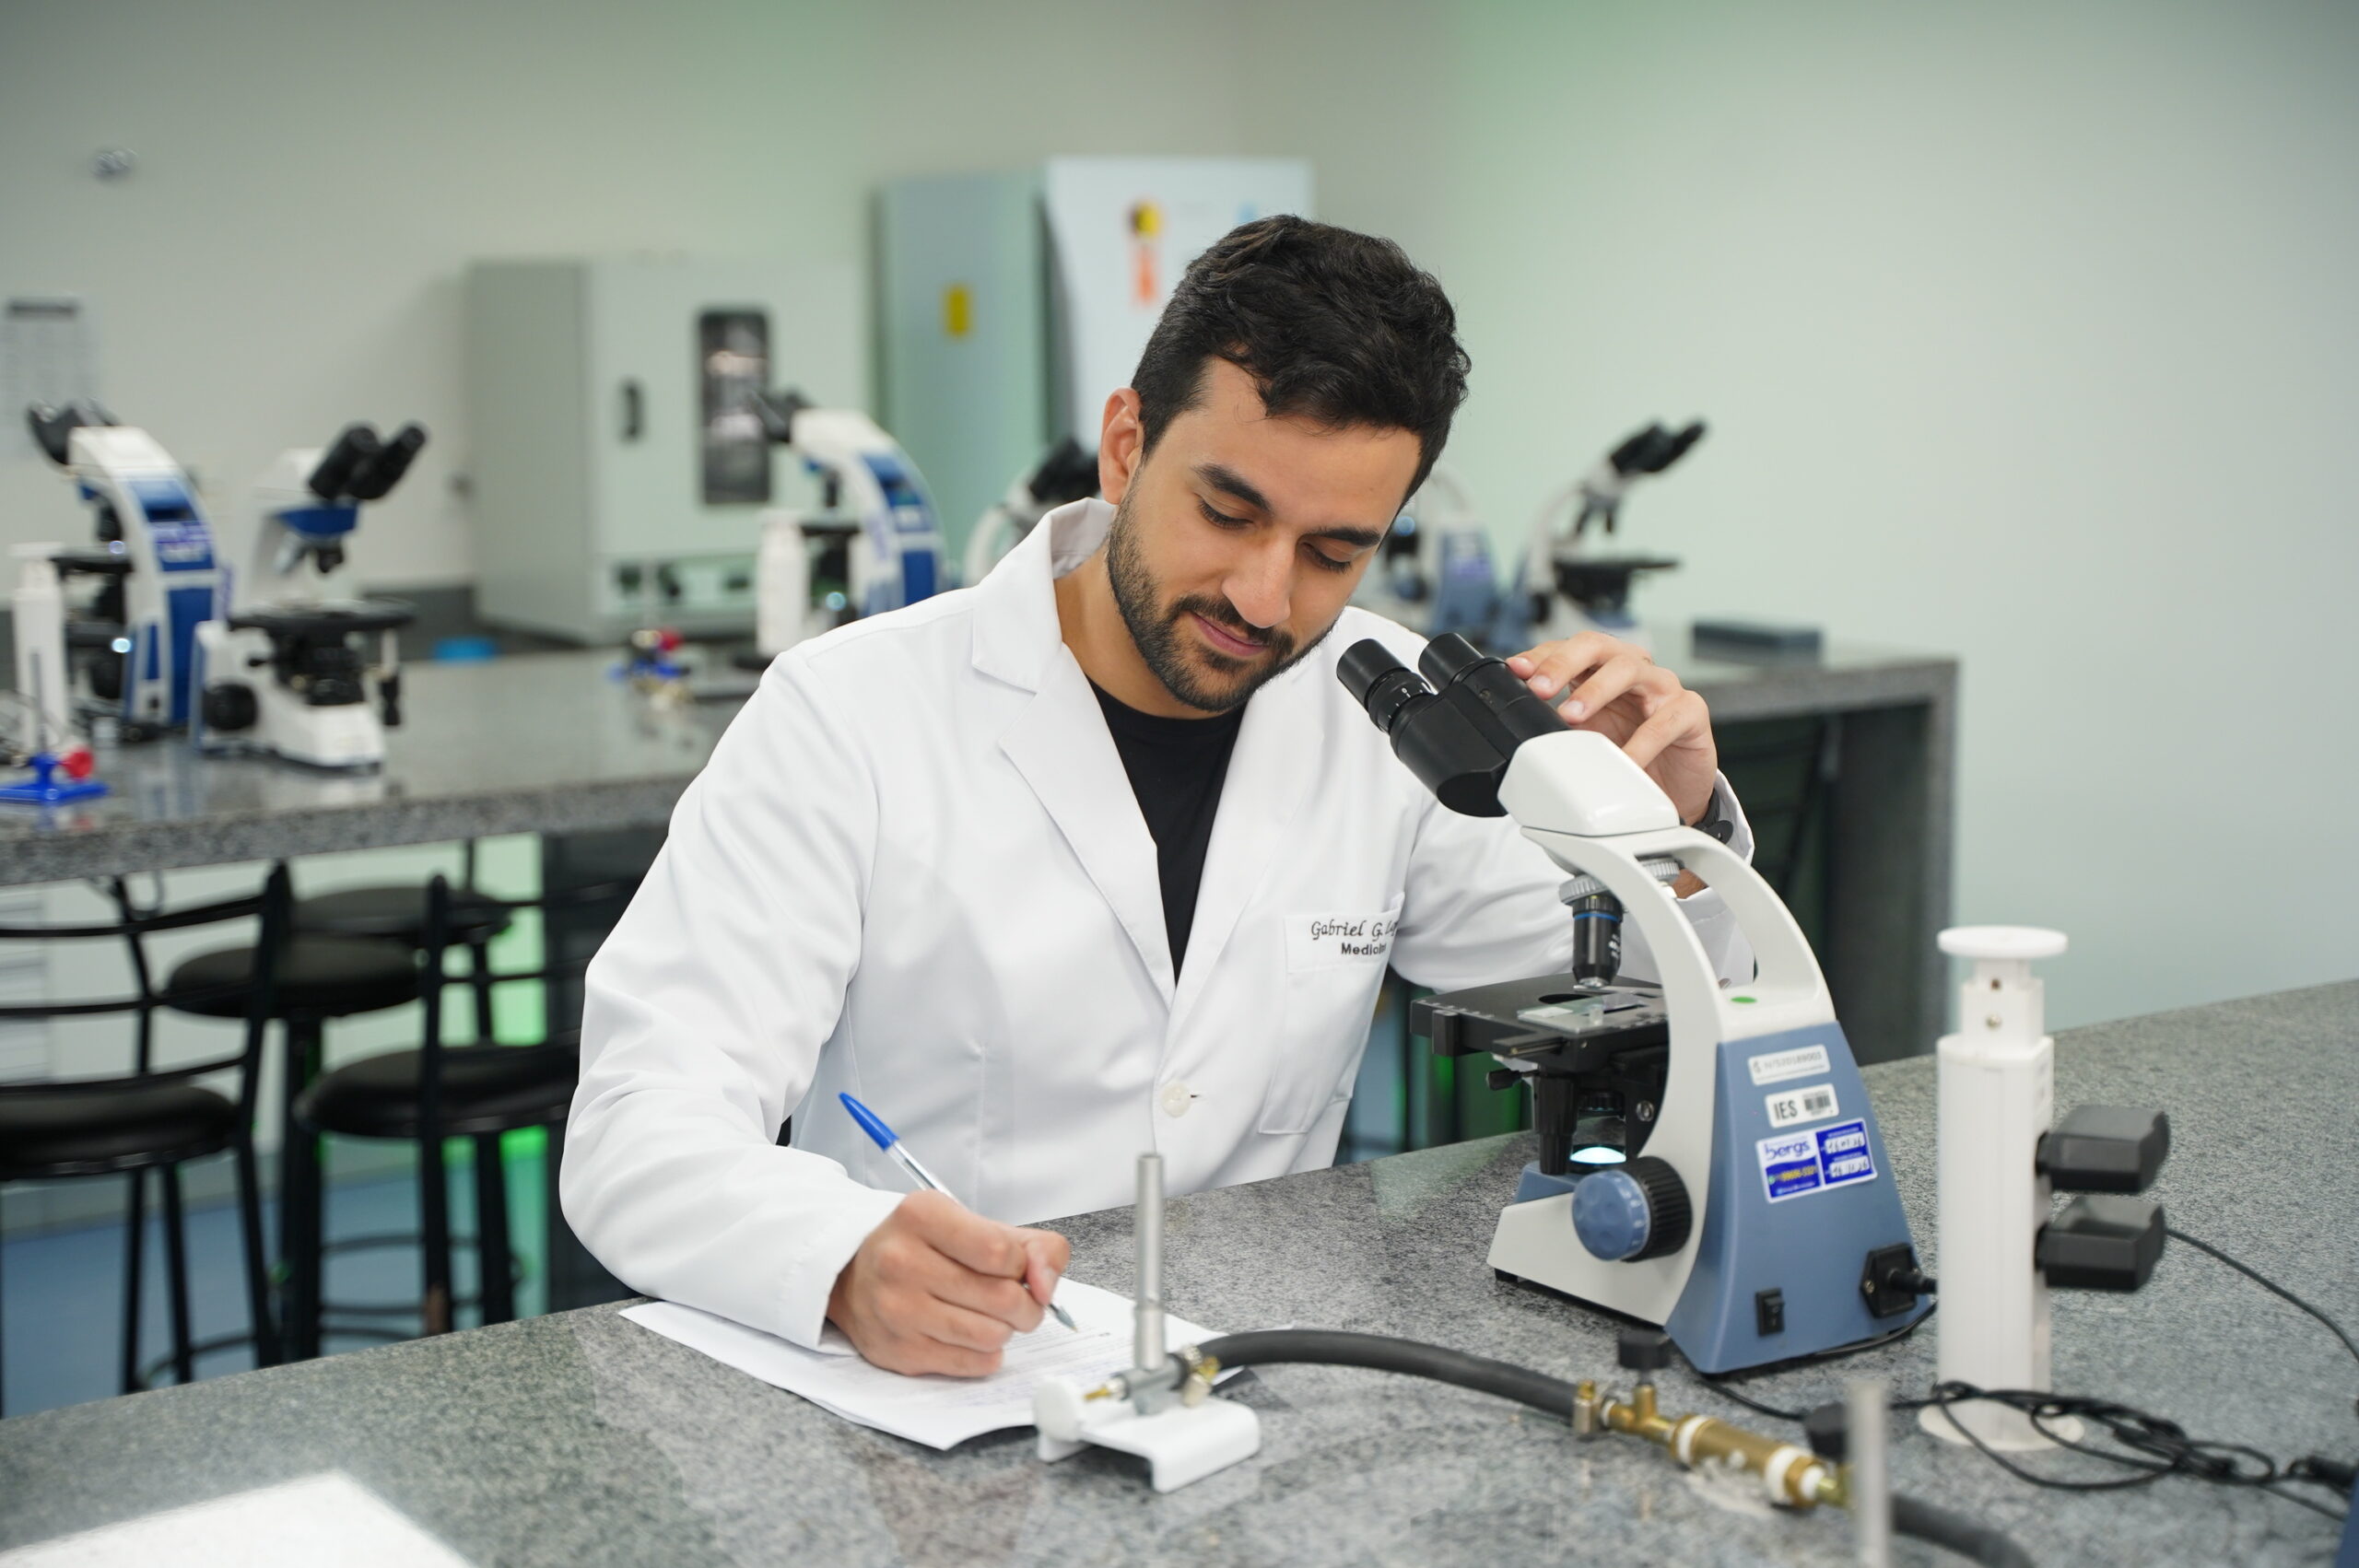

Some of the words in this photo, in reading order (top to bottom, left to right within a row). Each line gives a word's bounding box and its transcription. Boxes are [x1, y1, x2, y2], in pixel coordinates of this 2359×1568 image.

[1311, 919, 1367, 940] Gabriel
[1774, 1100, 1798, 1120] IES
[1766, 1141, 1810, 1160] bergs
